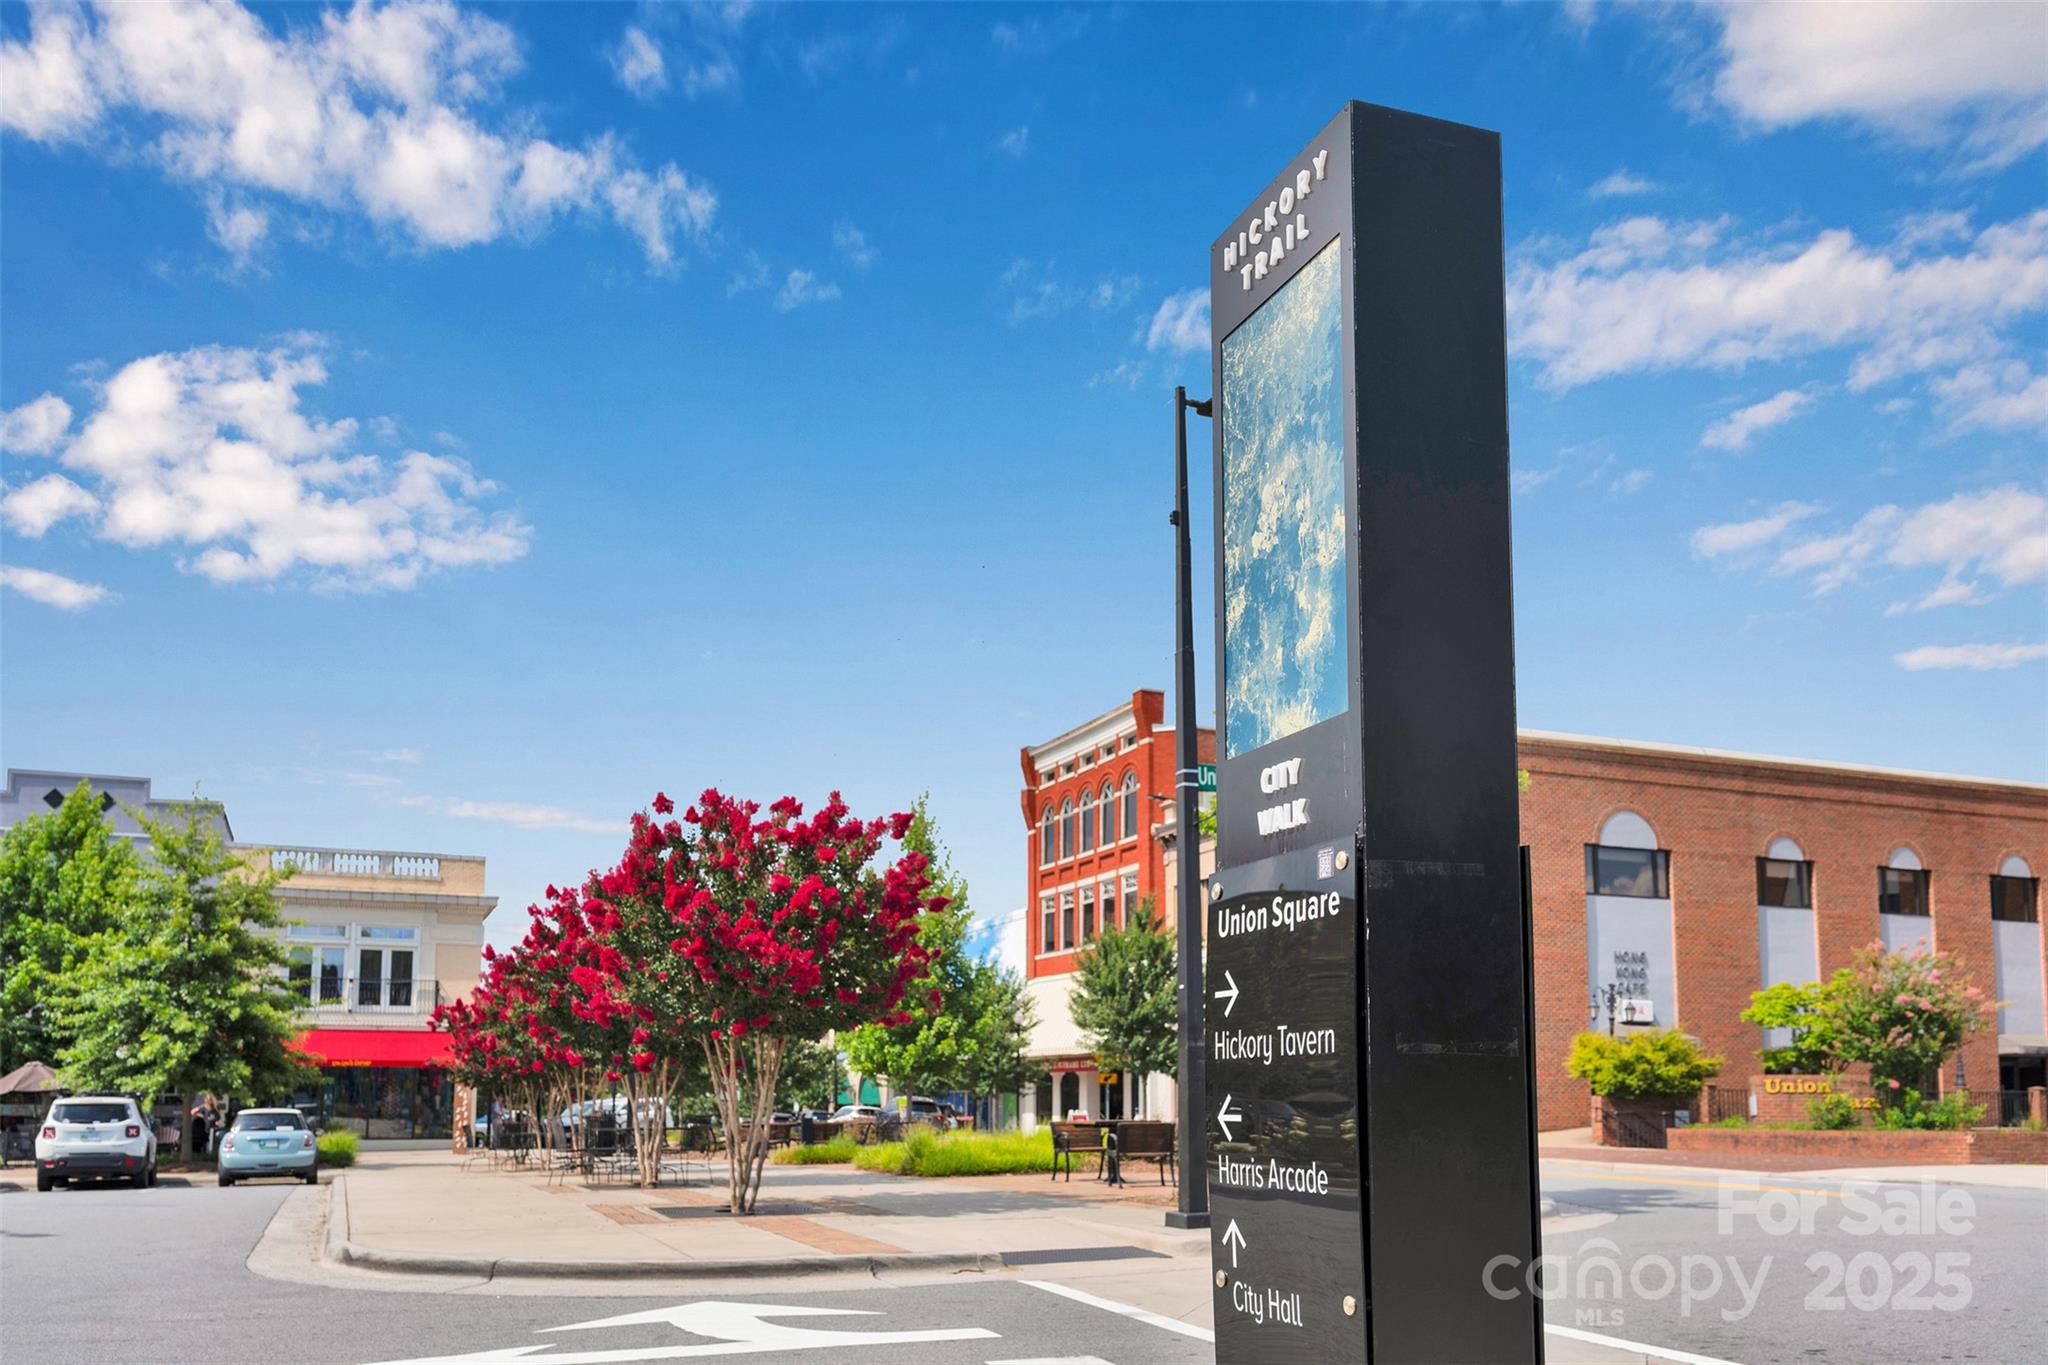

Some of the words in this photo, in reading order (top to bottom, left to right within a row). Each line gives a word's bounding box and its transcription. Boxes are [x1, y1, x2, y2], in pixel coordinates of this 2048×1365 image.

[1223, 149, 1328, 272] HICKORY
[1240, 213, 1310, 290] TRAIL
[1198, 766, 1216, 785] Un
[1260, 756, 1303, 794] CITY
[1257, 798, 1309, 836] WALK
[1218, 904, 1268, 938] Union
[1271, 890, 1340, 932] Square
[1214, 1030, 1273, 1066] Hickory
[1276, 1025, 1336, 1057] Tavern
[1764, 1078, 1832, 1095] Union
[1218, 1154, 1264, 1188] Harris
[1267, 1158, 1329, 1196] Arcade
[1232, 1281, 1263, 1324] City
[1268, 1288, 1304, 1328] Hall
